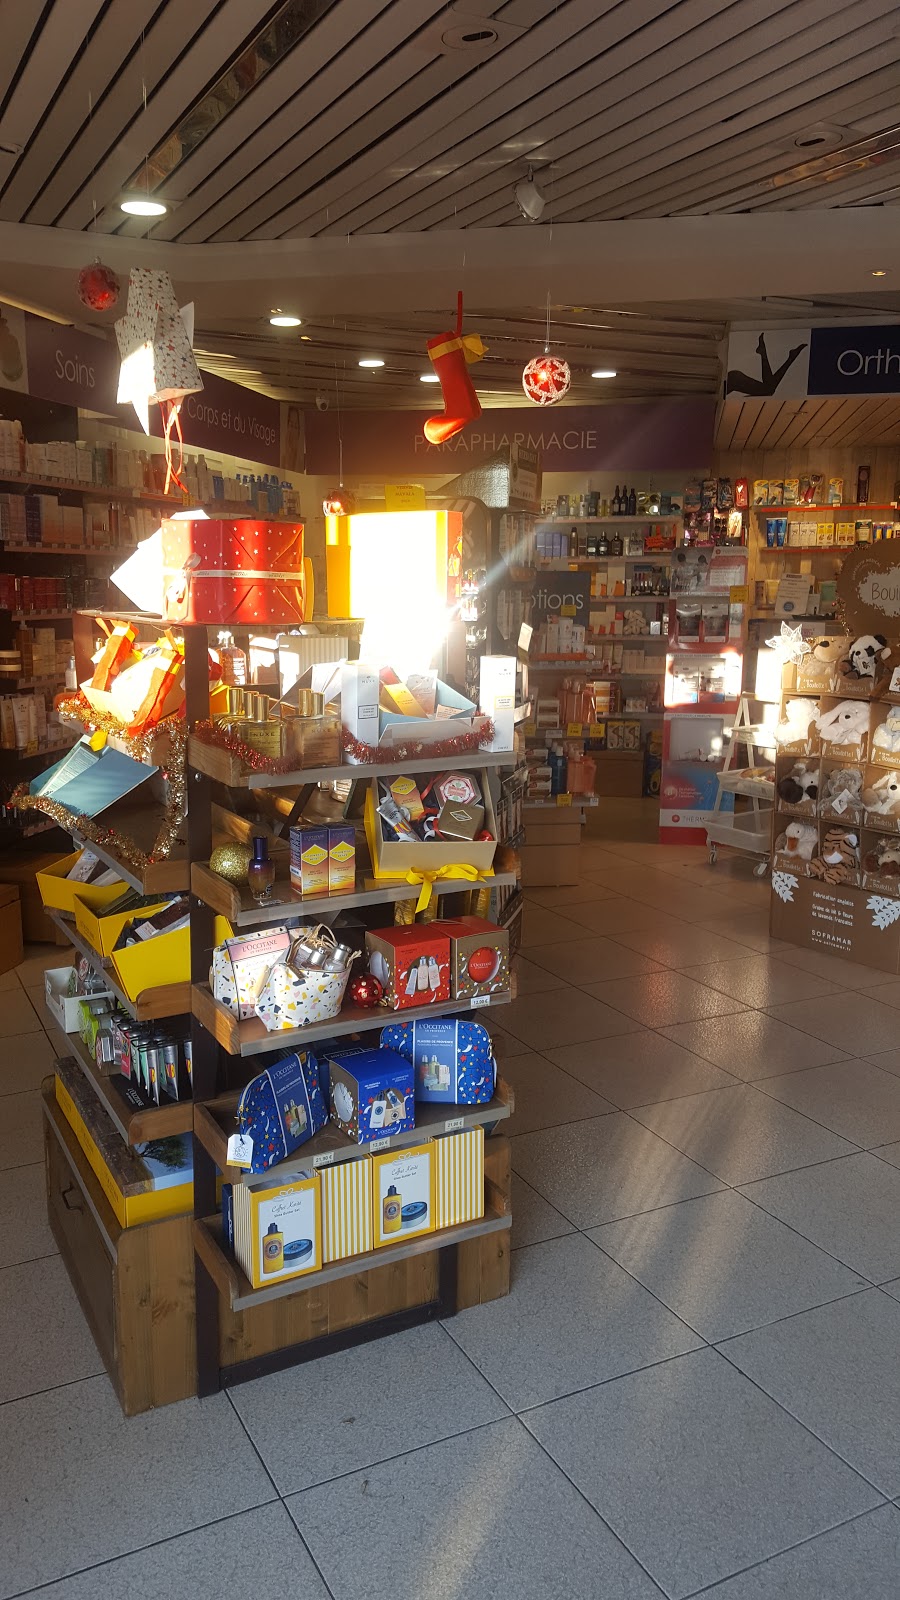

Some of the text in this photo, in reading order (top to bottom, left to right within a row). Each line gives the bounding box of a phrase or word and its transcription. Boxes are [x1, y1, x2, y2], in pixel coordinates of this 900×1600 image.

[55, 350, 96, 388] Soins
[188, 395, 219, 428] Corps
[221, 409, 232, 429] et
[233, 413, 246, 434] du
[248, 416, 276, 446] Visage
[242, 939, 278, 953] L'OCCITANE
[812, 929, 852, 946] SOFRAMAR
